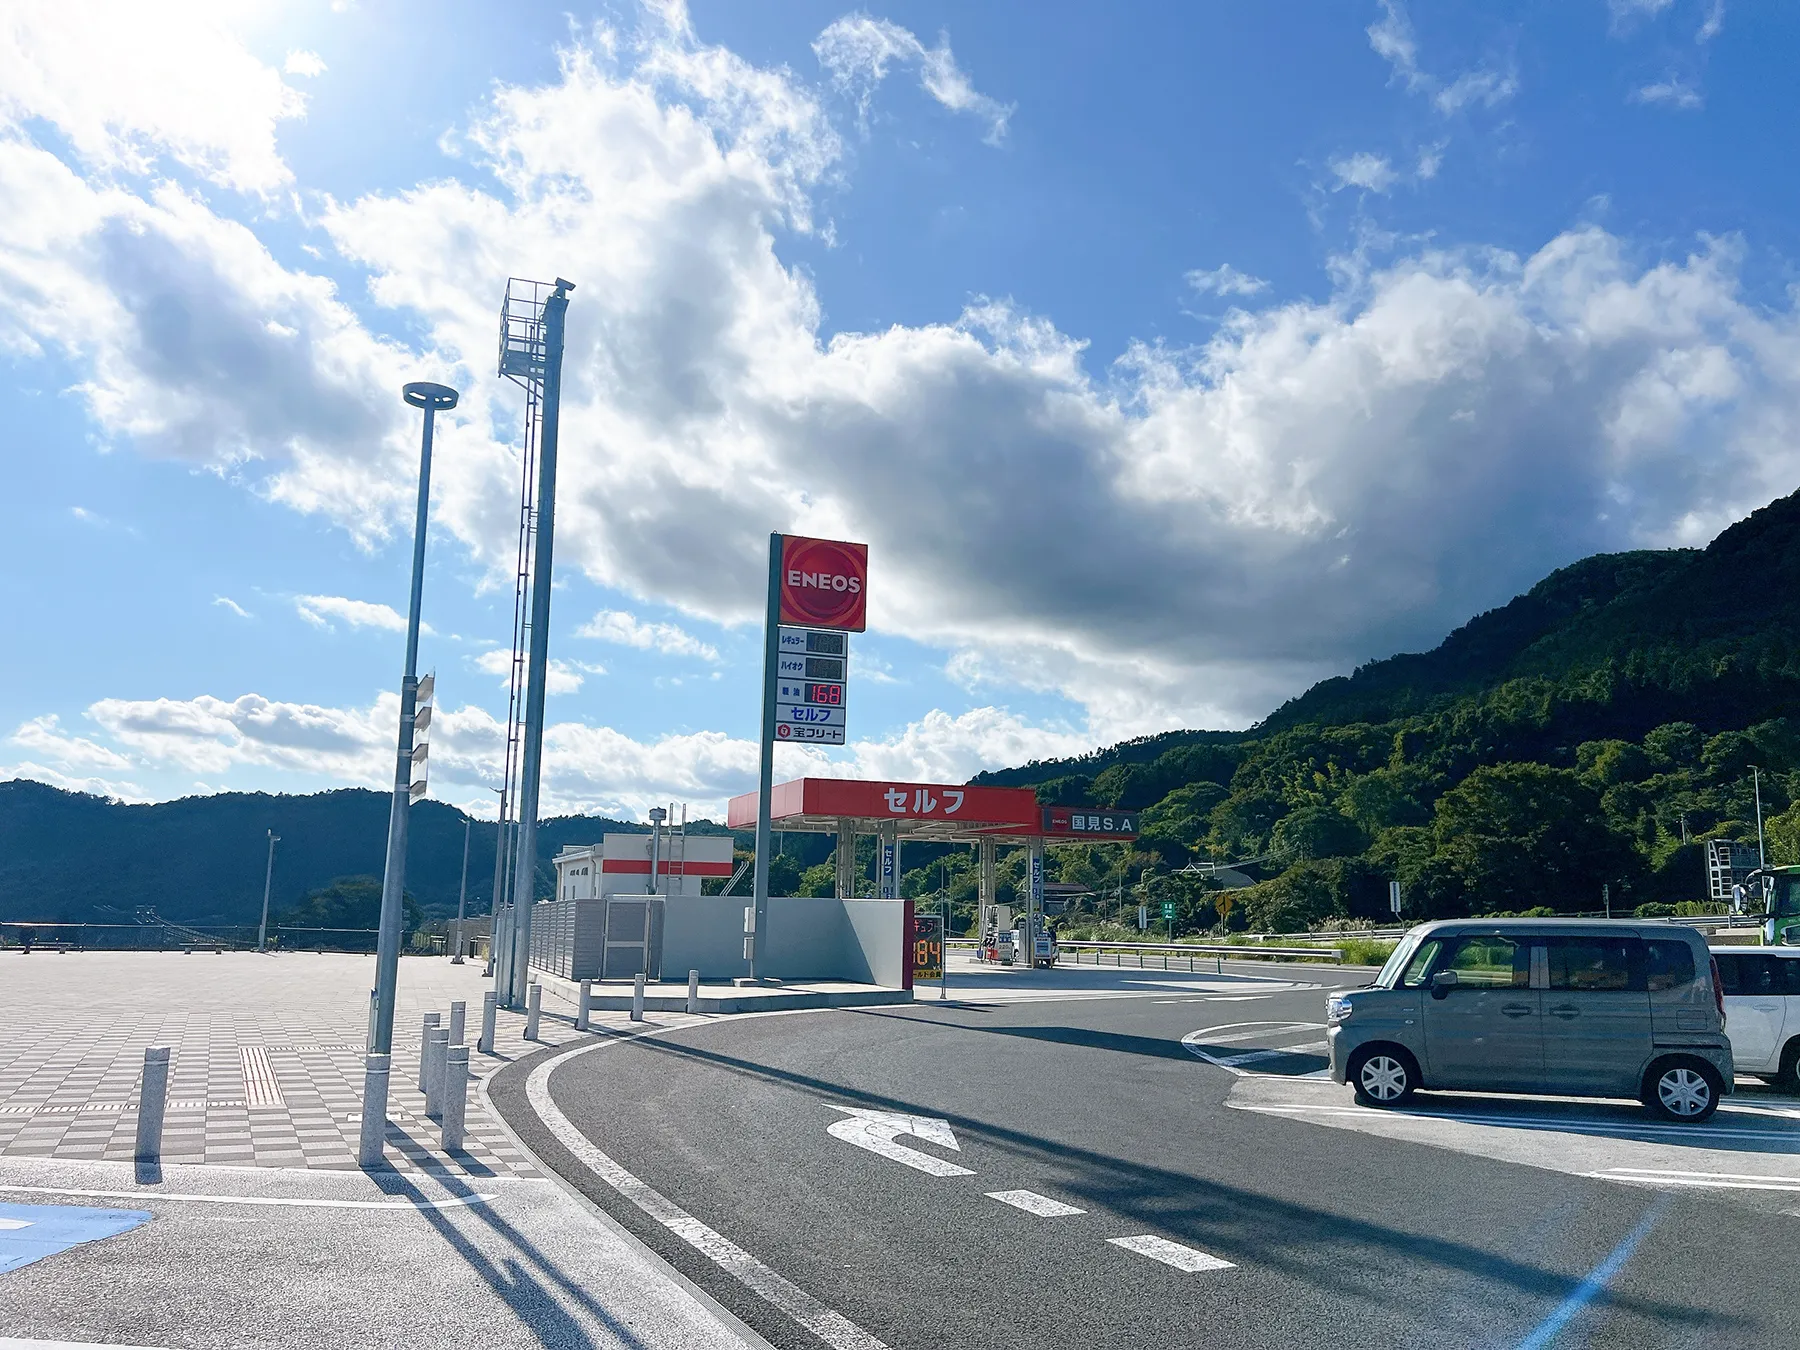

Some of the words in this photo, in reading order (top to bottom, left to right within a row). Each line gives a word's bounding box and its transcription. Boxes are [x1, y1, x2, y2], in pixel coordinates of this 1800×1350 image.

[788, 569, 861, 593] ENEOS
[782, 635, 804, 645] レギュラー
[781, 661, 803, 671] ハイオク
[812, 684, 841, 704] 168
[791, 707, 831, 722] セルフ
[884, 787, 965, 815] セルフ
[1072, 815, 1133, 832] 国見S.A
[884, 849, 892, 874] セルフ
